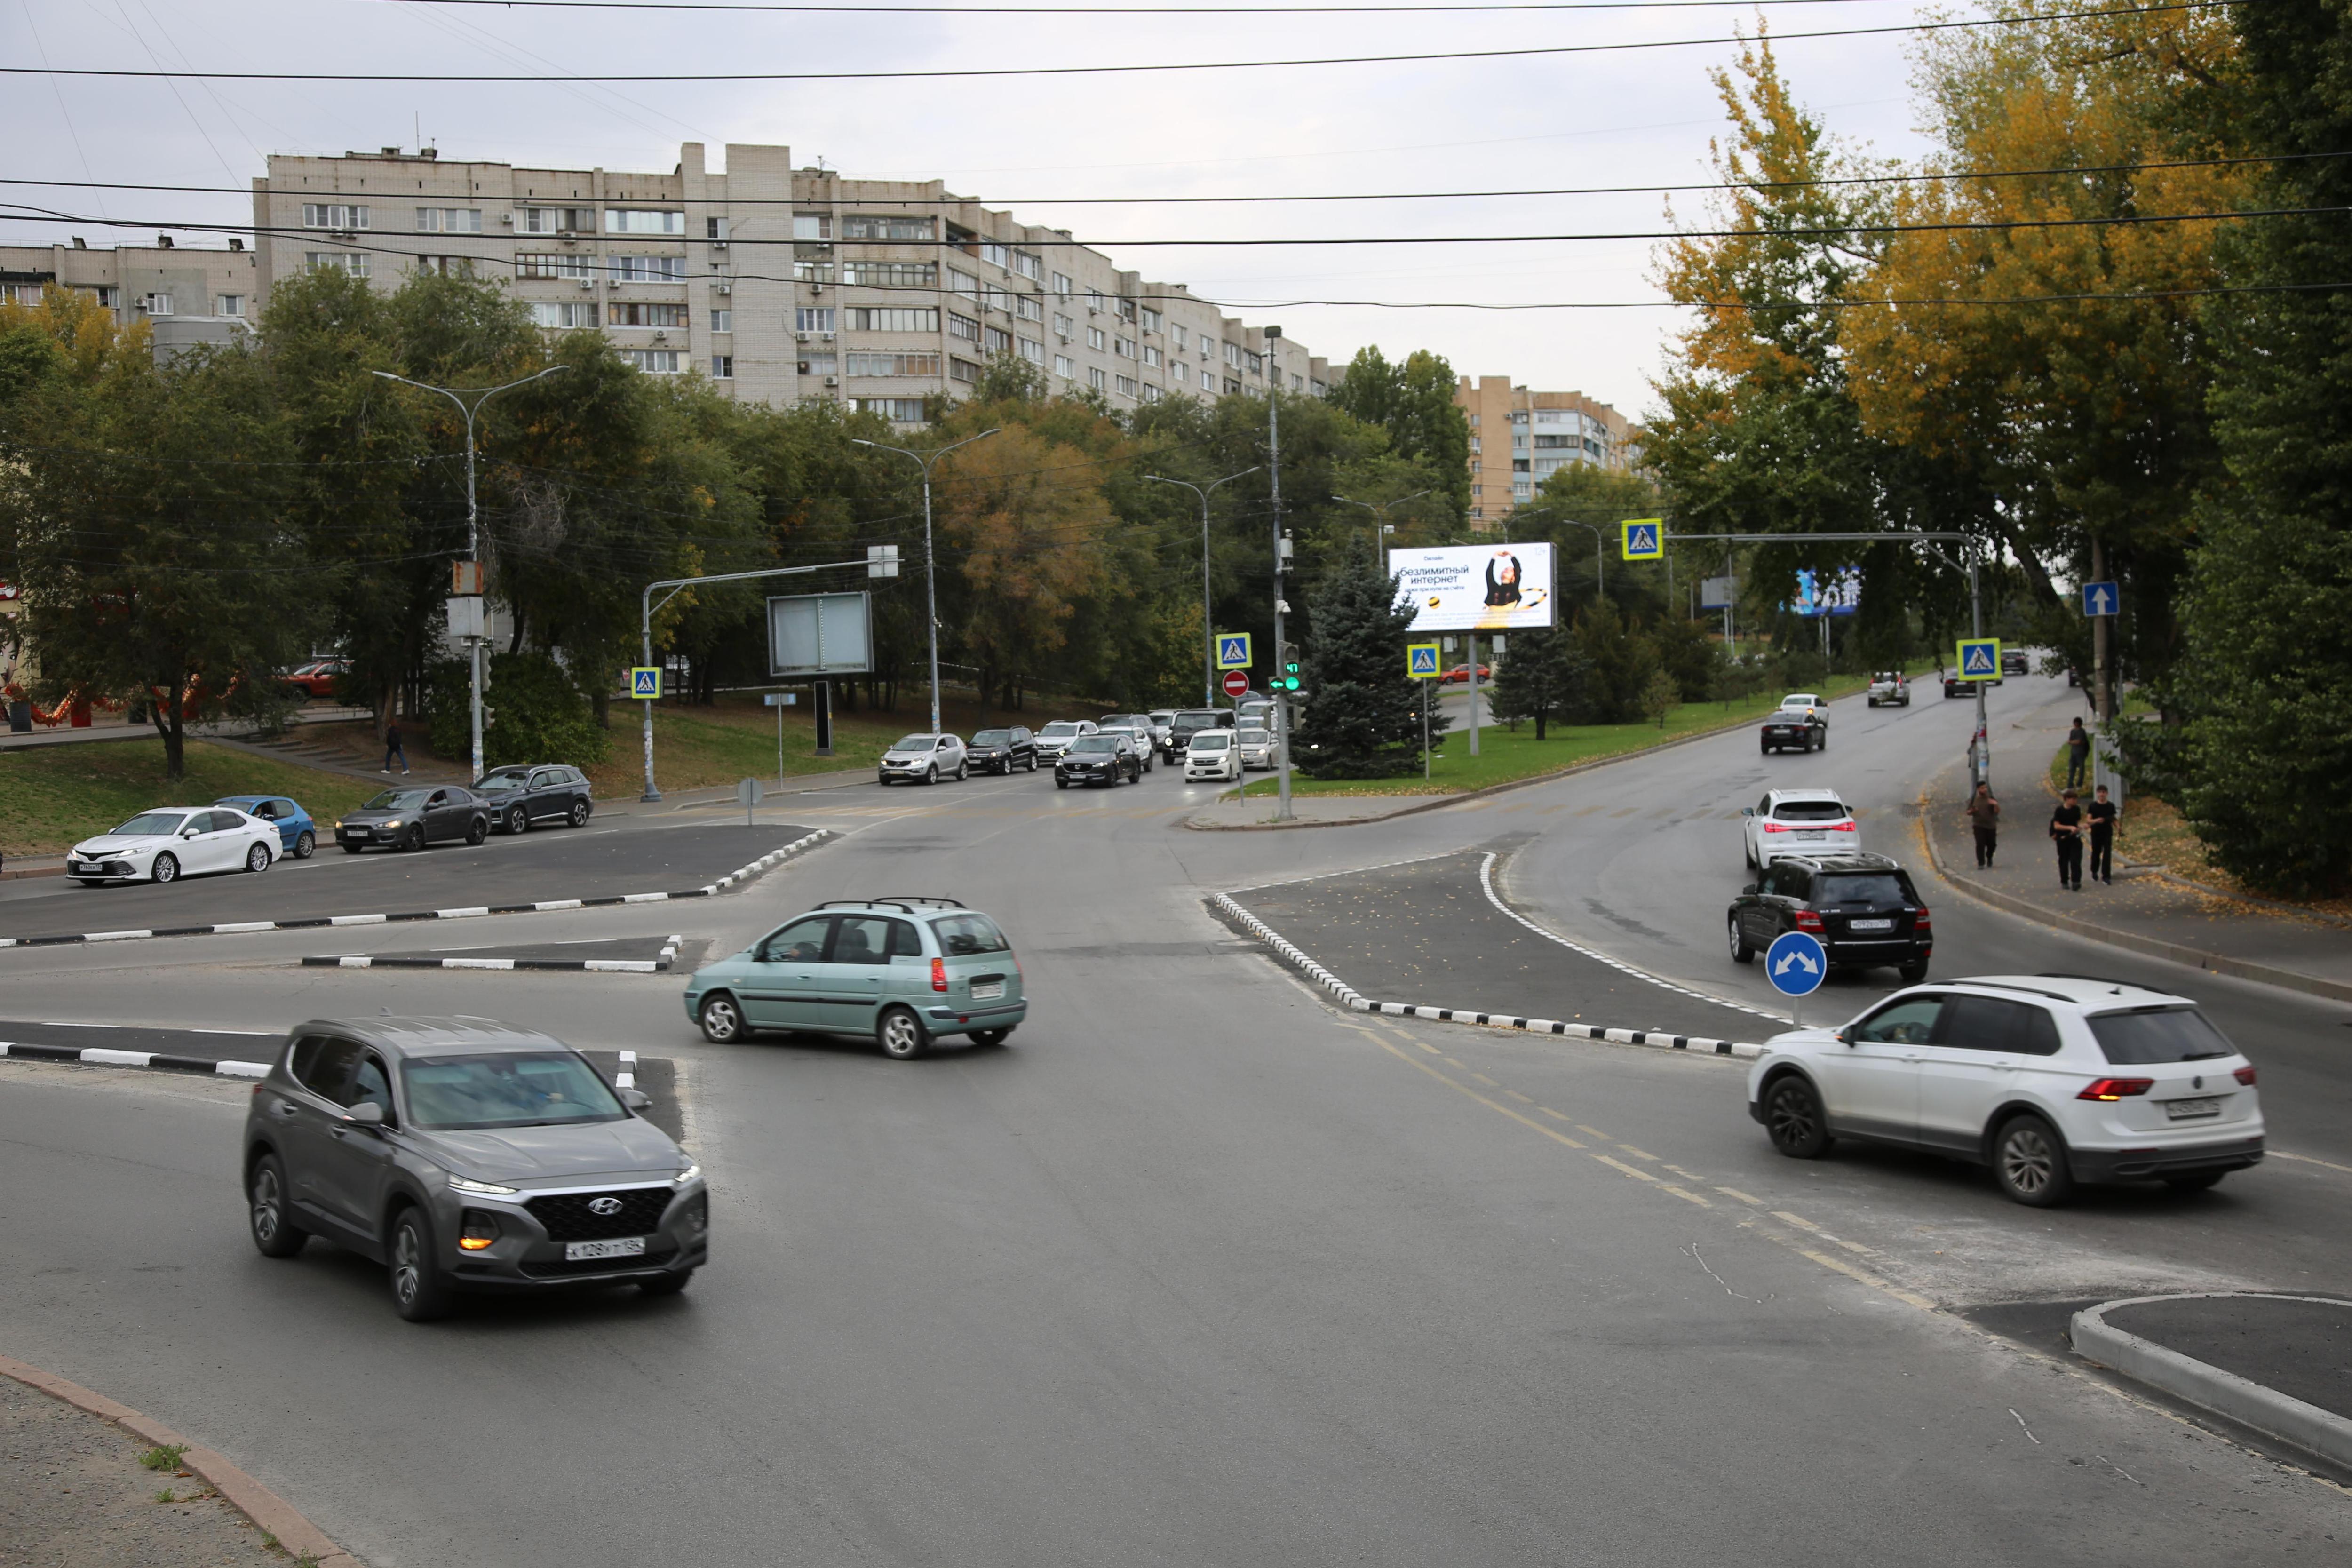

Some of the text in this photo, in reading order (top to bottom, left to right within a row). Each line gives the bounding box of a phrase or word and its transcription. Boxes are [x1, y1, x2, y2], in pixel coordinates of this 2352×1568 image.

[1400, 565, 1469, 576] безлимитный
[1411, 575, 1458, 585] интернет
[1287, 663, 1298, 673] 47
